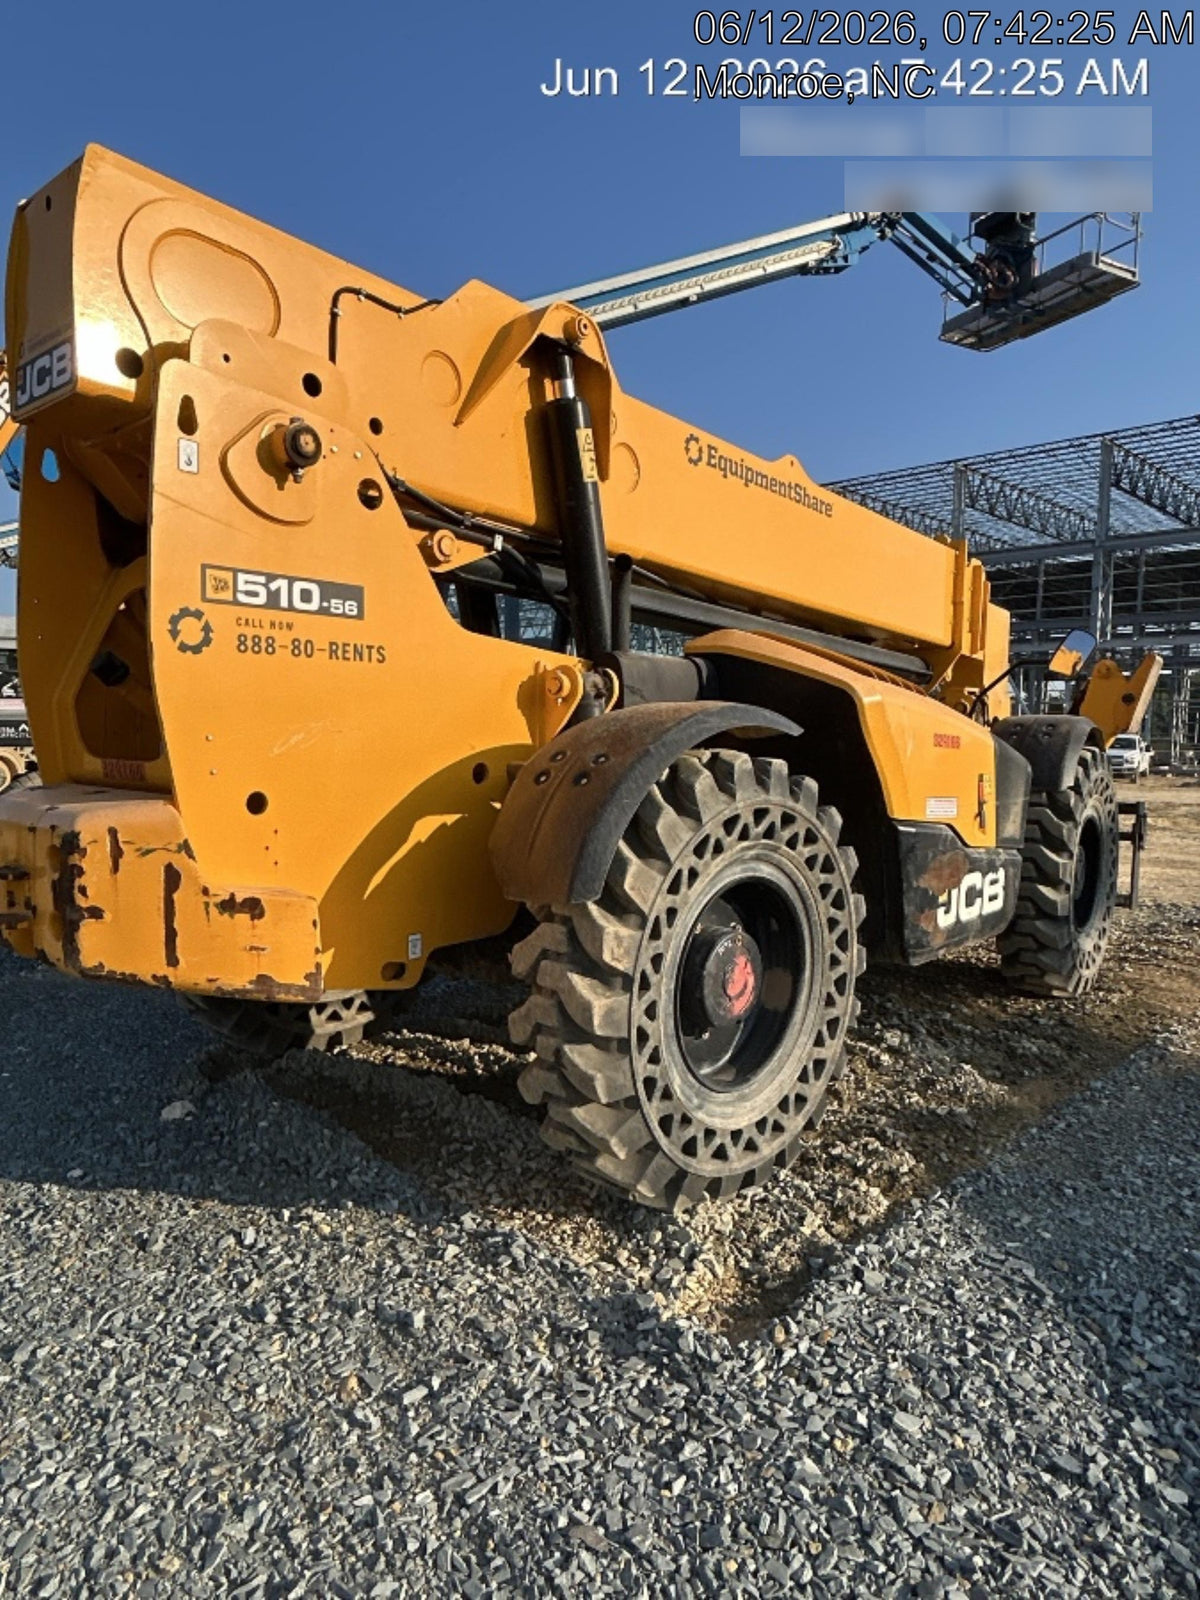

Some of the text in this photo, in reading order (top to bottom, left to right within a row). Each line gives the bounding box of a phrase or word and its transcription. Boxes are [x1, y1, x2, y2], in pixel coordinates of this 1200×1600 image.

[17, 342, 72, 406] JCB
[706, 444, 833, 518] EquipmentShare
[236, 571, 358, 616] 510-56
[236, 616, 294, 631] CALL NOW
[236, 633, 387, 664] 888-80-RENTS
[936, 867, 1005, 928] JCB
